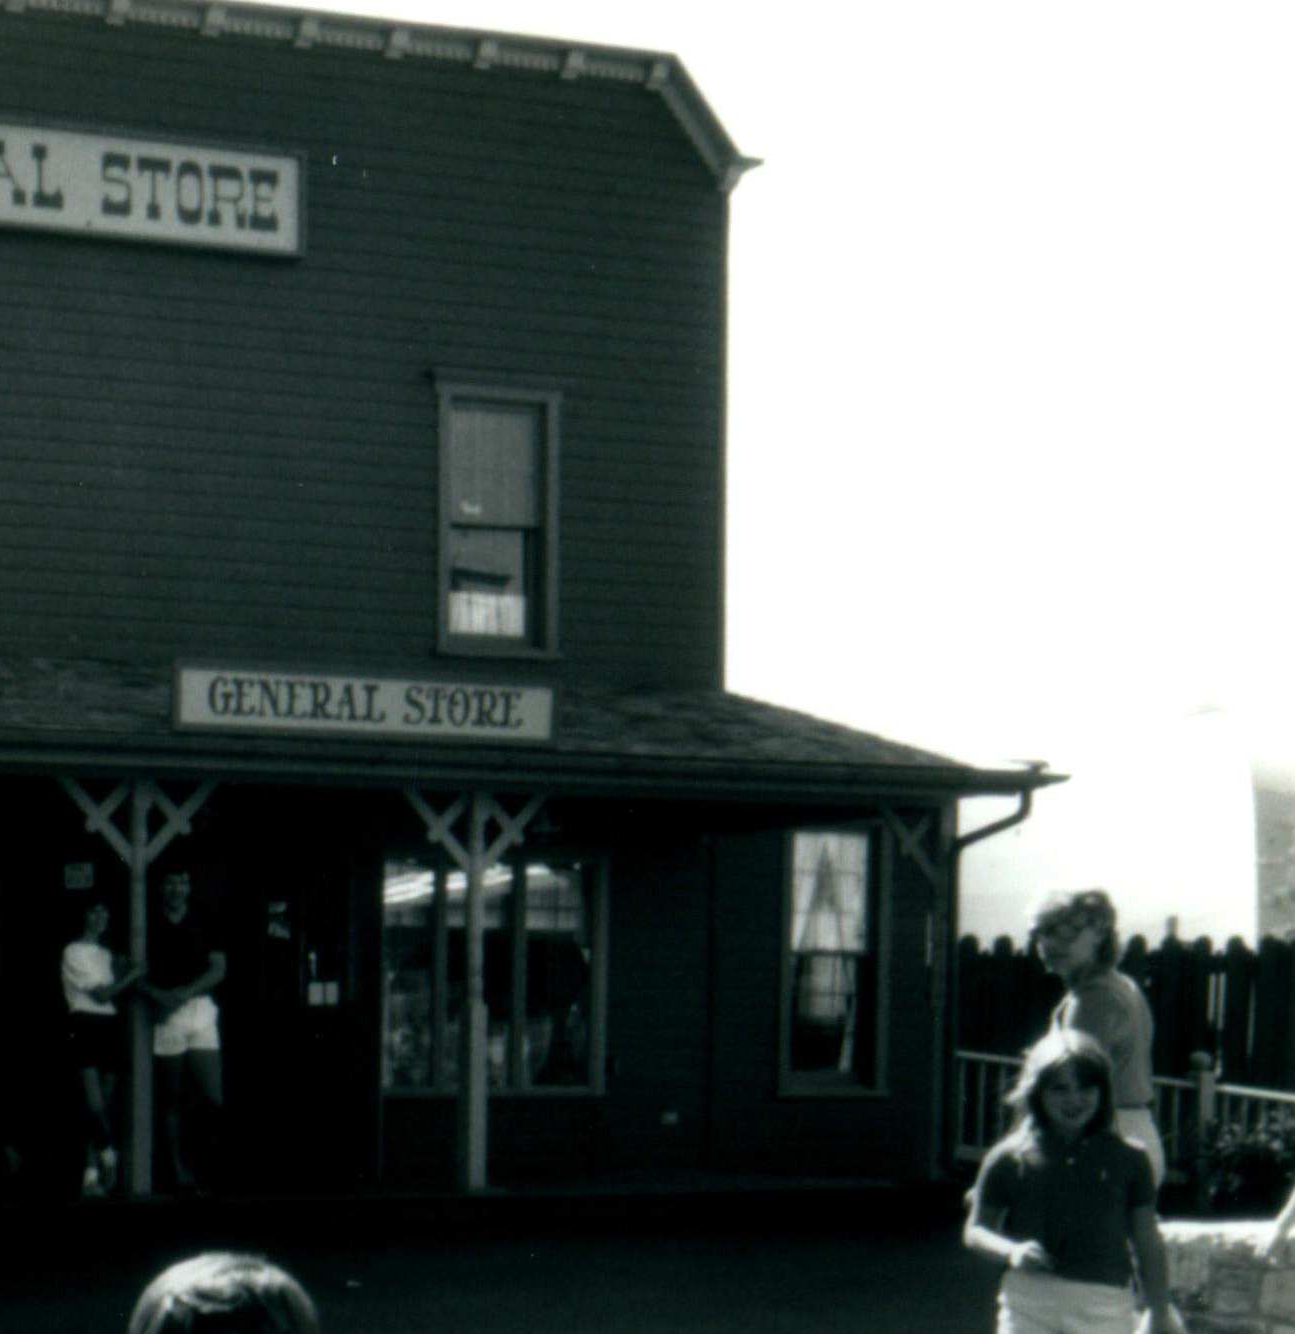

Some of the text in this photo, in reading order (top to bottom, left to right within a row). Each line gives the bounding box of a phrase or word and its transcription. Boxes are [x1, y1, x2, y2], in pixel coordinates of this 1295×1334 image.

[101, 151, 279, 232] STORE
[208, 675, 524, 729] GENERAL STORE
